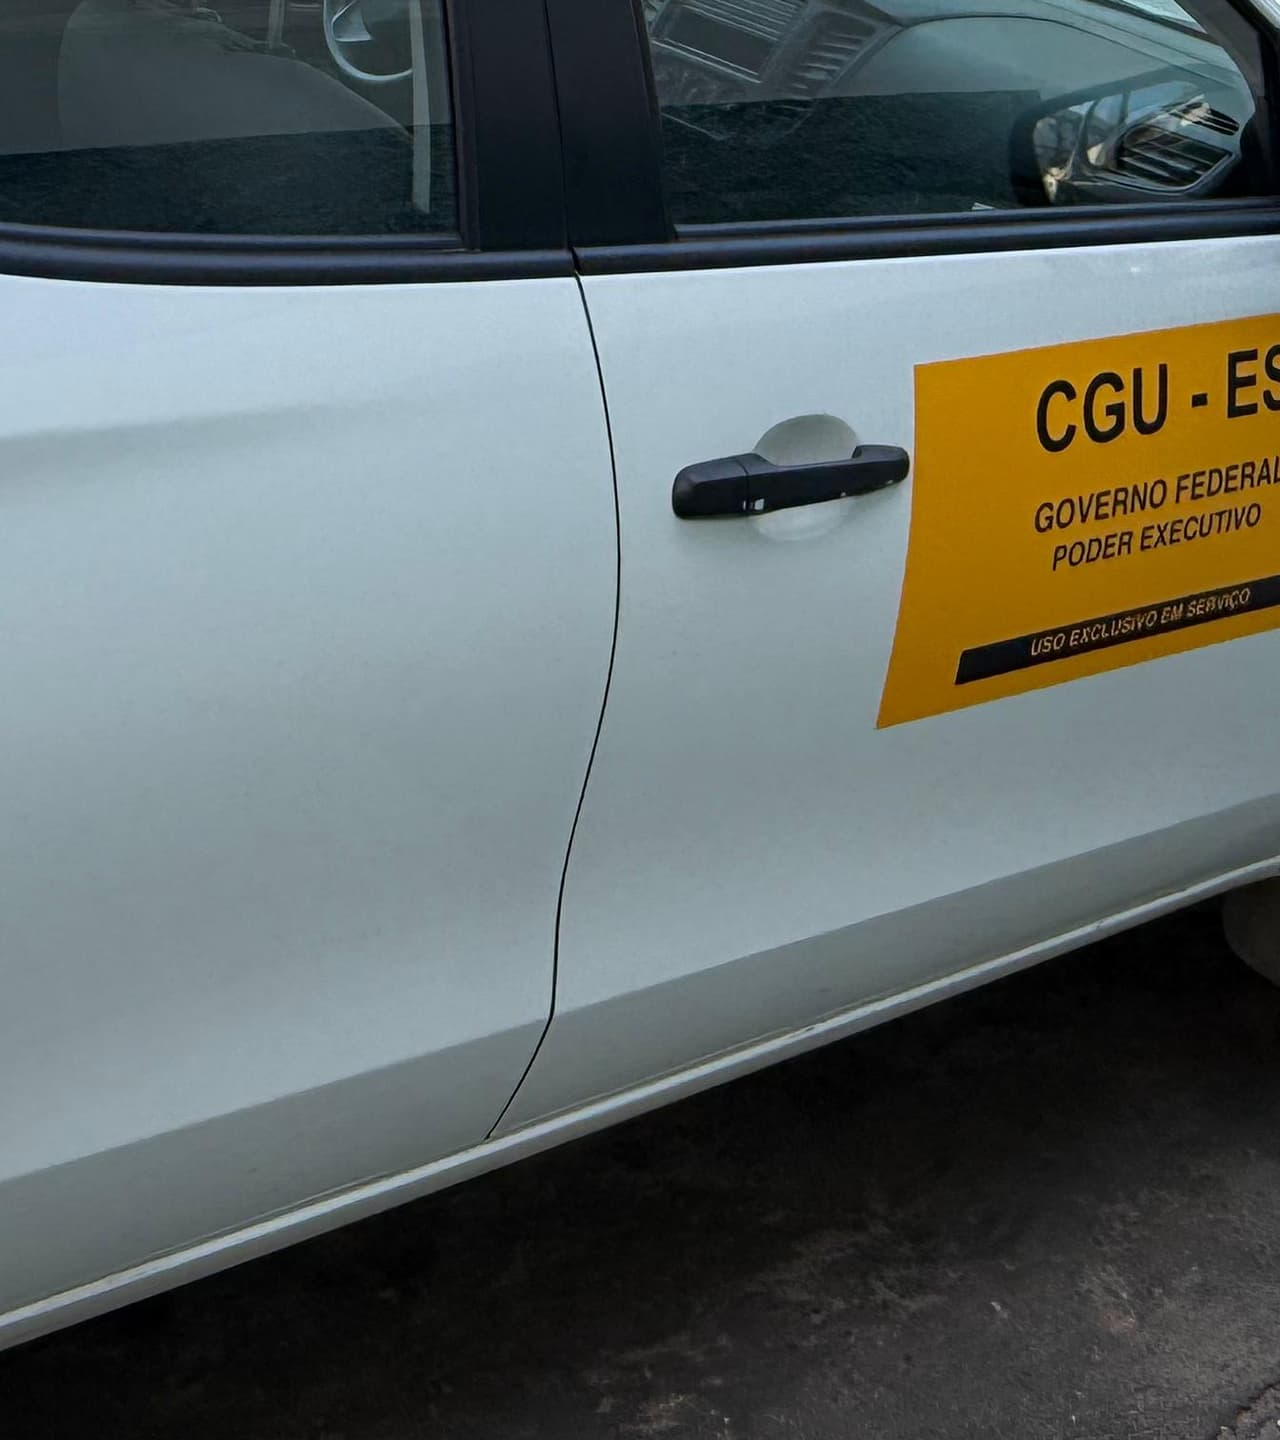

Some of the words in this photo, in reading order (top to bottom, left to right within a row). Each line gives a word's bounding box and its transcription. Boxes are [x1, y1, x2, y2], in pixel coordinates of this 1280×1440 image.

[1035, 363, 1168, 452] CGU
[1034, 479, 1168, 533] GOVERNO
[1052, 531, 1133, 572] PODER
[1139, 503, 1262, 551] EXECUTIVO
[1030, 632, 1066, 656] USO
[1069, 610, 1157, 647] EXCLUSIVO
[1160, 602, 1185, 625] EM
[1186, 587, 1251, 619] SERVIÇO
